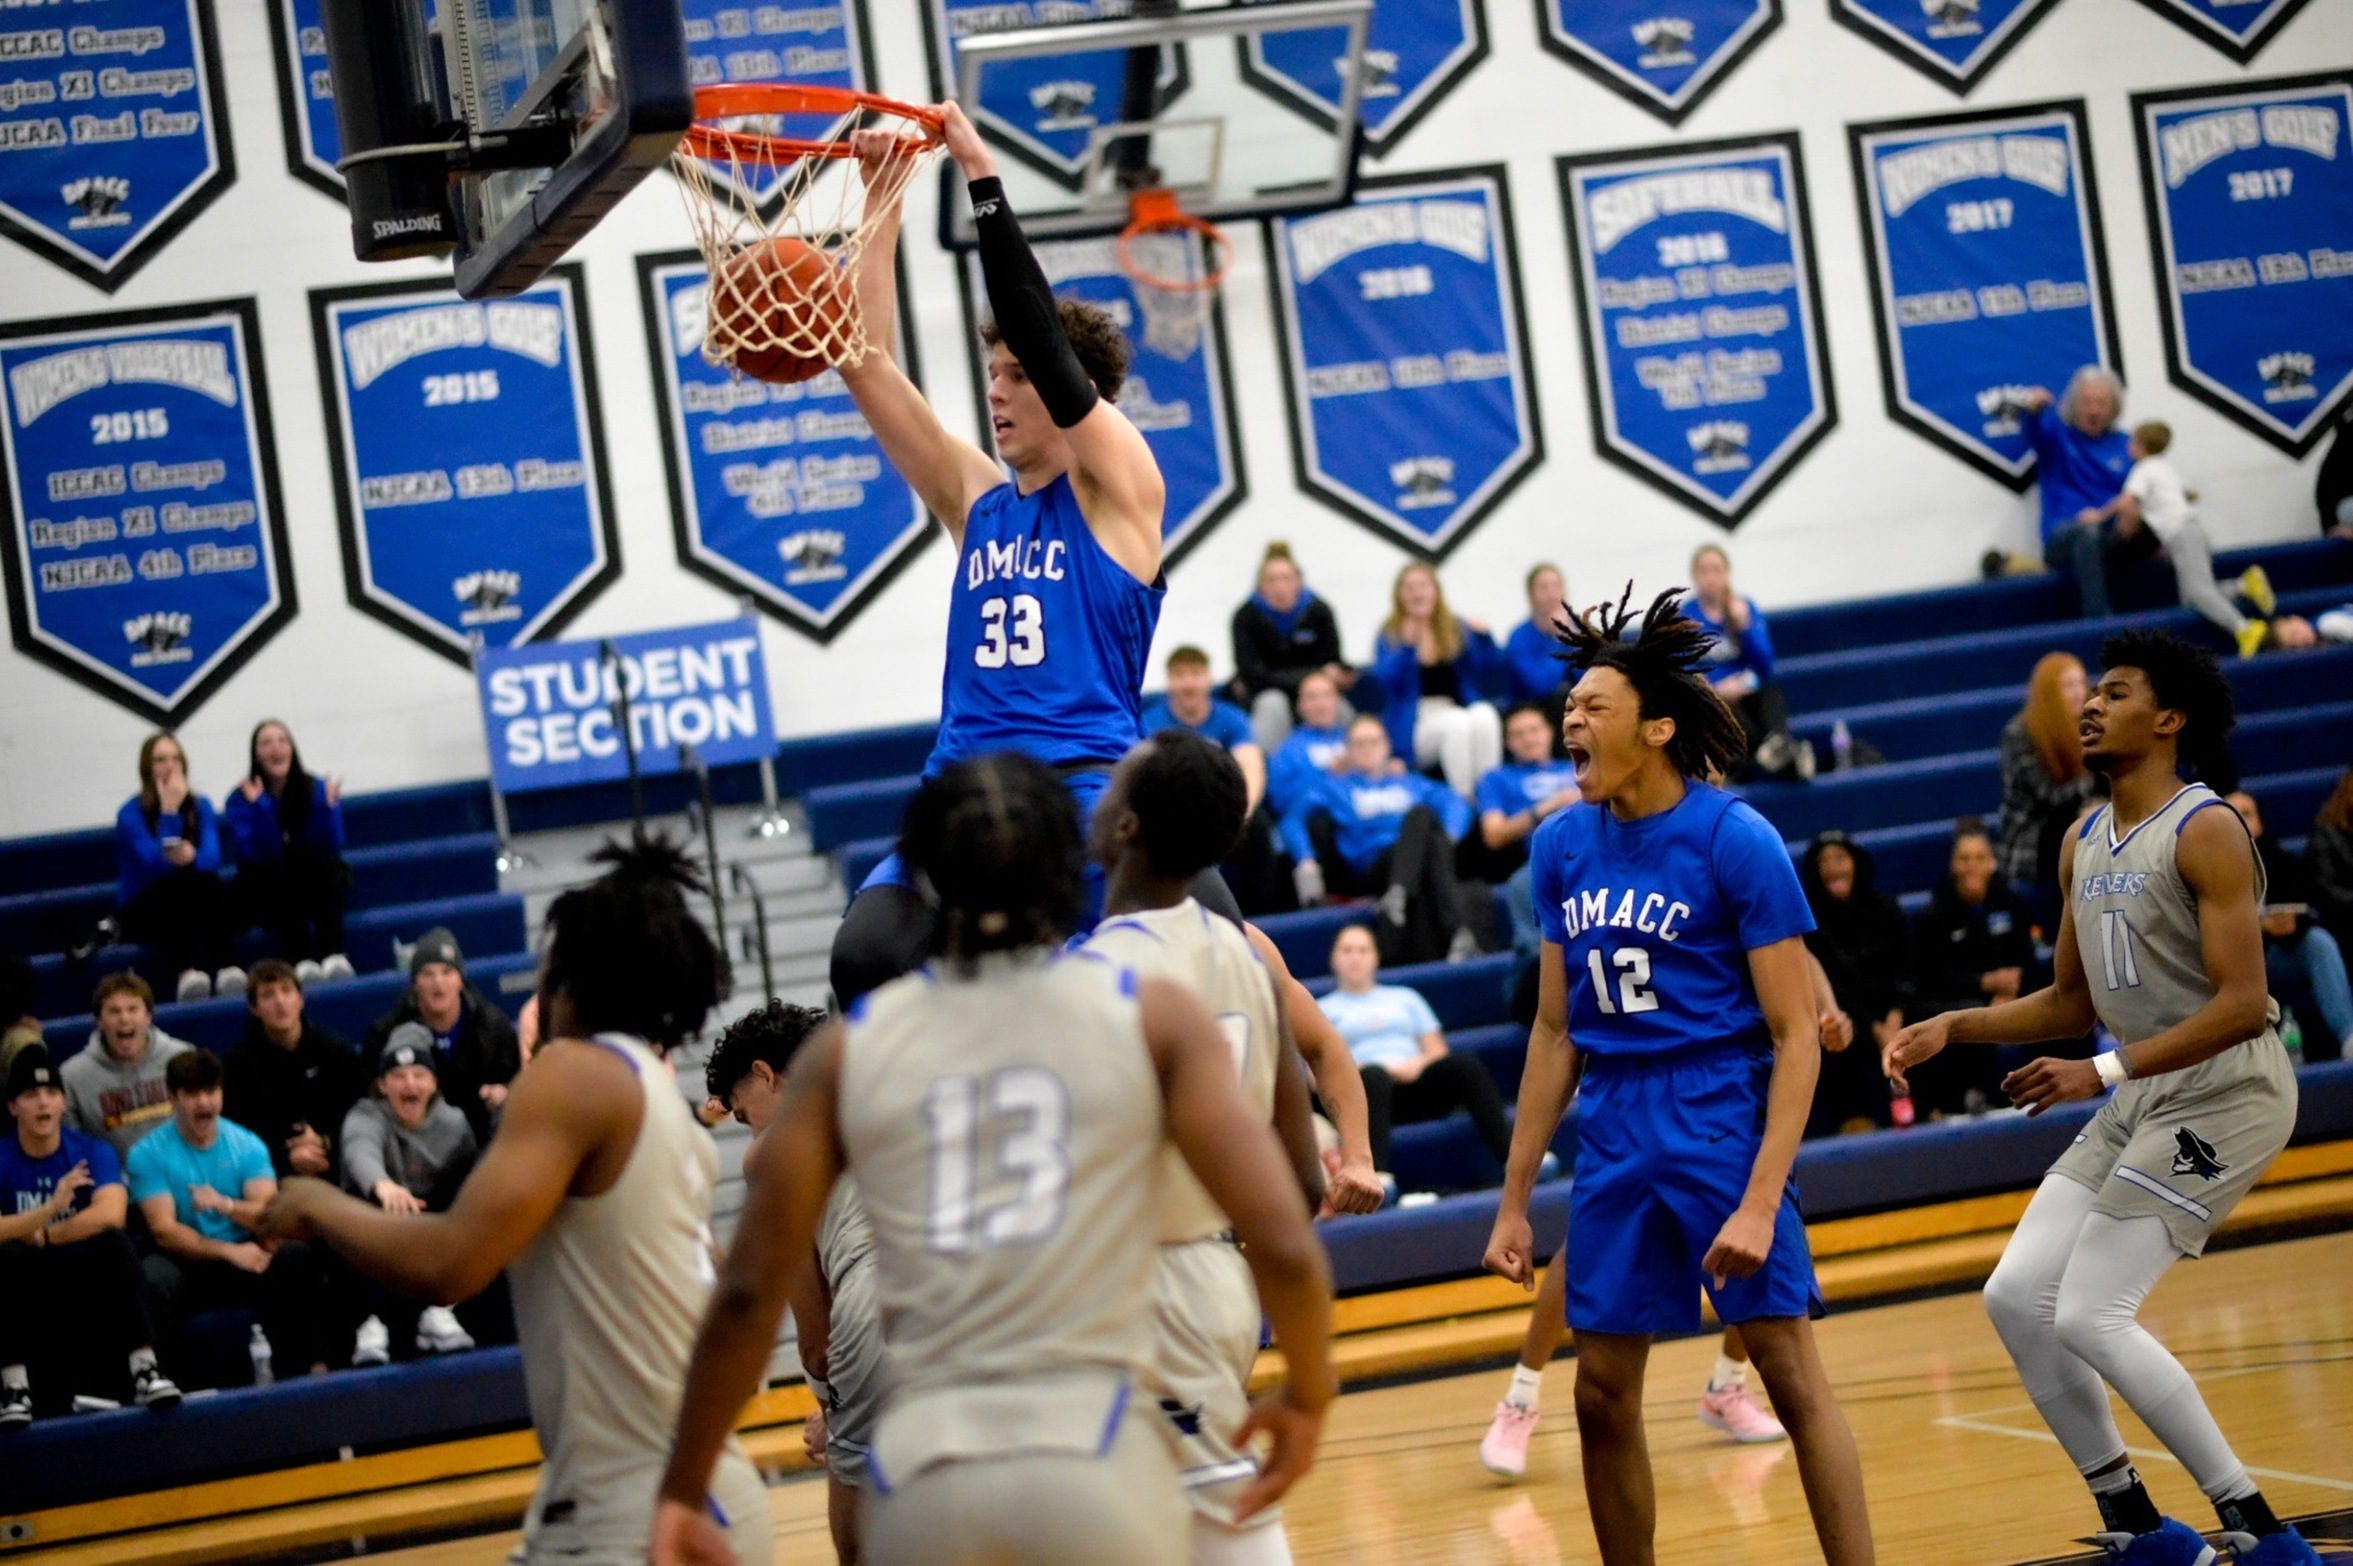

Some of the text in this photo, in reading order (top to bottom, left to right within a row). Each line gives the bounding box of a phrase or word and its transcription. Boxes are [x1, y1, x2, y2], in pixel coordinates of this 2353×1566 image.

[69, 27, 163, 54] Champs
[61, 71, 94, 99] XI
[99, 68, 194, 97] Champs
[72, 112, 136, 143] Final
[2228, 168, 2293, 201] 2017
[372, 213, 442, 239] SPALDING
[1946, 197, 2013, 234] 2017
[422, 370, 499, 406] 2015
[91, 407, 168, 444] 2015
[48, 460, 225, 499] ICCAC Champs
[31, 519, 116, 549] Region
[161, 501, 254, 532] Champs
[41, 554, 131, 591] NJCAA
[188, 543, 256, 574] Place
[974, 594, 1045, 668] 33
[489, 637, 757, 716] STUDENT
[505, 691, 757, 767] SECTION
[1562, 888, 1690, 941] DMACC
[2102, 909, 2140, 991] 11
[1587, 948, 1659, 1014] 12
[925, 1065, 1073, 1252] 13
